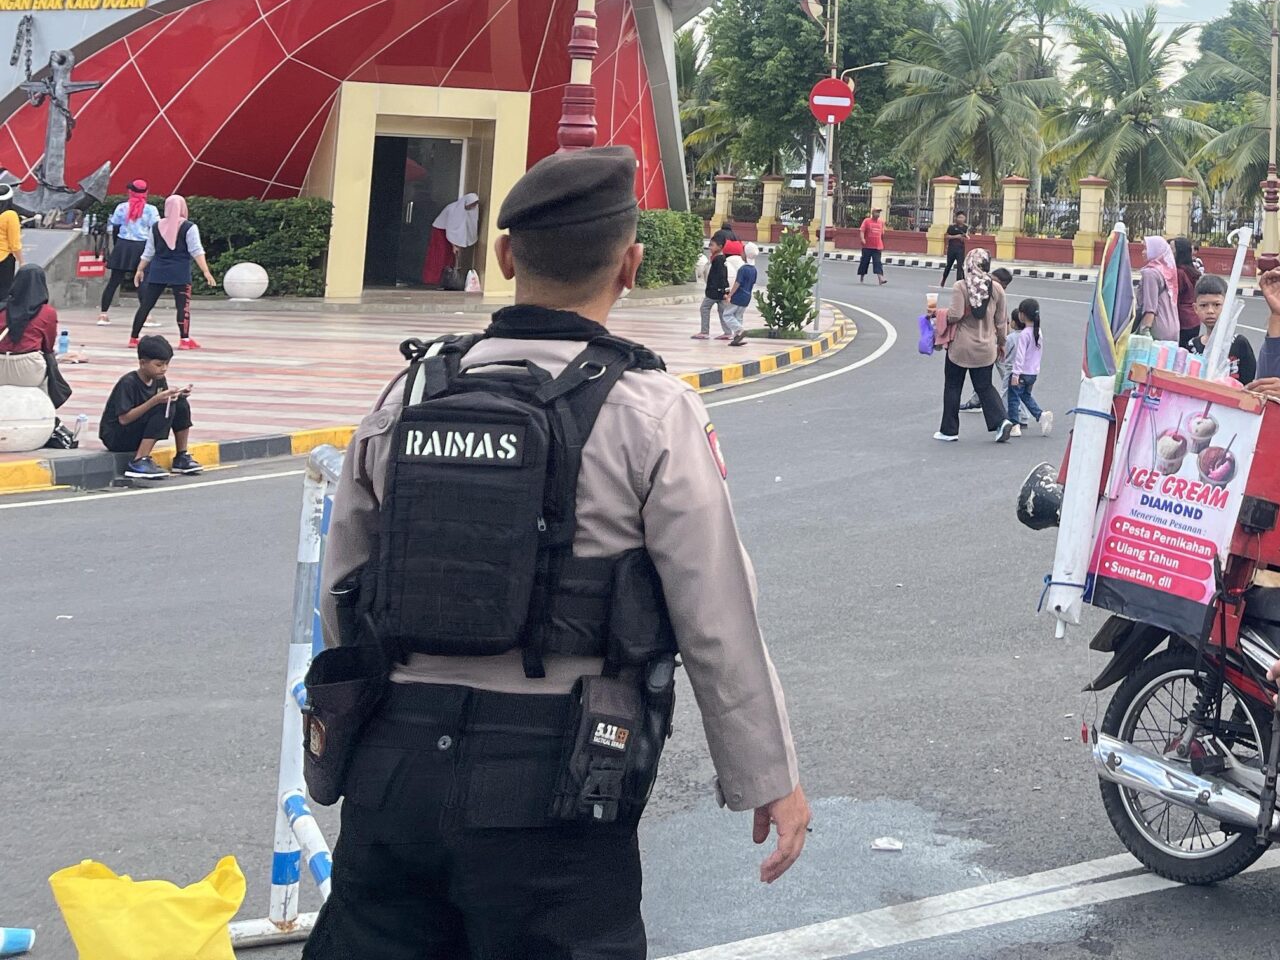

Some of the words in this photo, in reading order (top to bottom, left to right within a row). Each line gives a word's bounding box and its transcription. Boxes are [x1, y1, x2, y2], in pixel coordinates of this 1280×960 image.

[1126, 466, 1160, 491] ICE
[1162, 475, 1230, 509] CREAM
[1140, 494, 1203, 520] DIAMOND
[1129, 508, 1168, 526] Menerima
[1169, 519, 1203, 535] Pesanan
[1122, 521, 1151, 539] Pesta
[1153, 531, 1212, 556] Pernikahan
[1116, 541, 1146, 560] Ulang
[1149, 550, 1179, 569] Tahun
[1110, 561, 1156, 586] Sunatan,
[1158, 576, 1172, 589] dll
